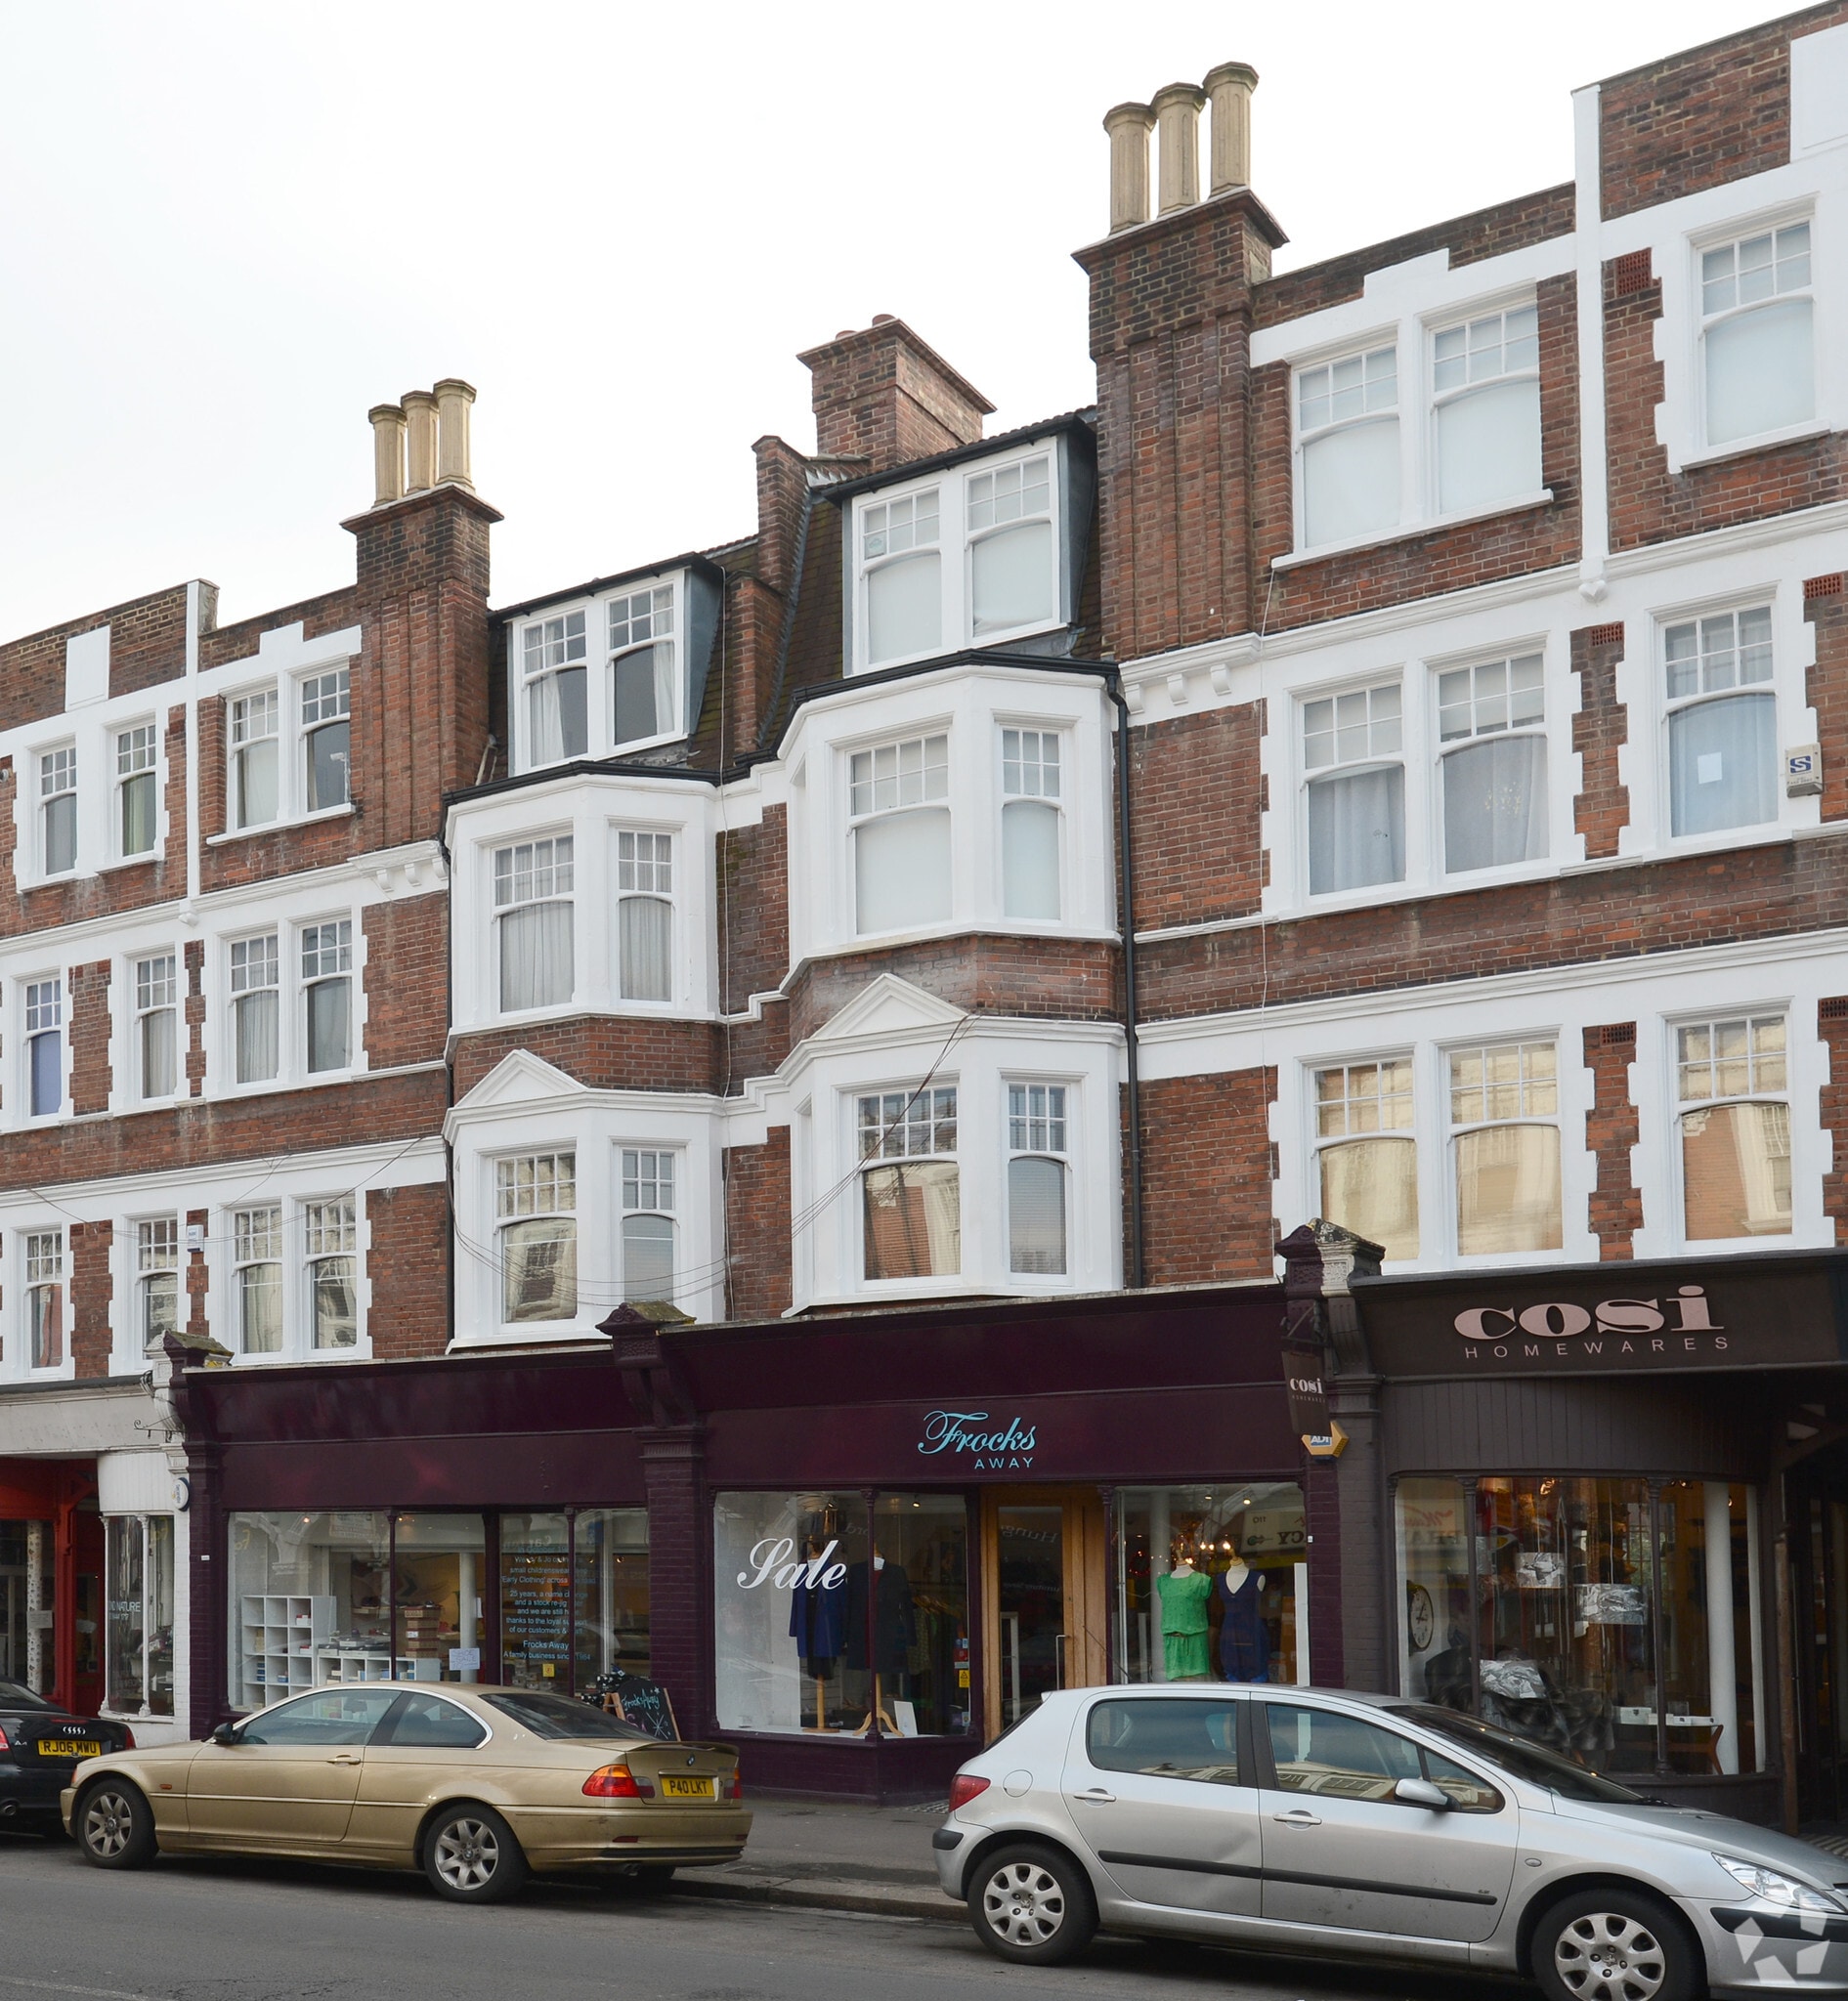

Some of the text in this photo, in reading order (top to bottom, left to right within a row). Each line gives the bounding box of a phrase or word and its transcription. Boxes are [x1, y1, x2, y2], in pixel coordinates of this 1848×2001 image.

[1454, 1285, 1724, 1340] cosi
[1465, 1337, 1728, 1359] HOMEWARES
[1290, 1378, 1323, 1394] cosi
[918, 1410, 1036, 1455] Frocks
[974, 1457, 1033, 1469] AWAY
[737, 1538, 847, 1590] Sale
[546, 1617, 558, 1626] loyal
[523, 1640, 569, 1651] Frocks Away
[509, 1650, 527, 1659] family
[43, 1741, 97, 1754] RJ06 MWU
[668, 1780, 708, 1794] P40 LKT
